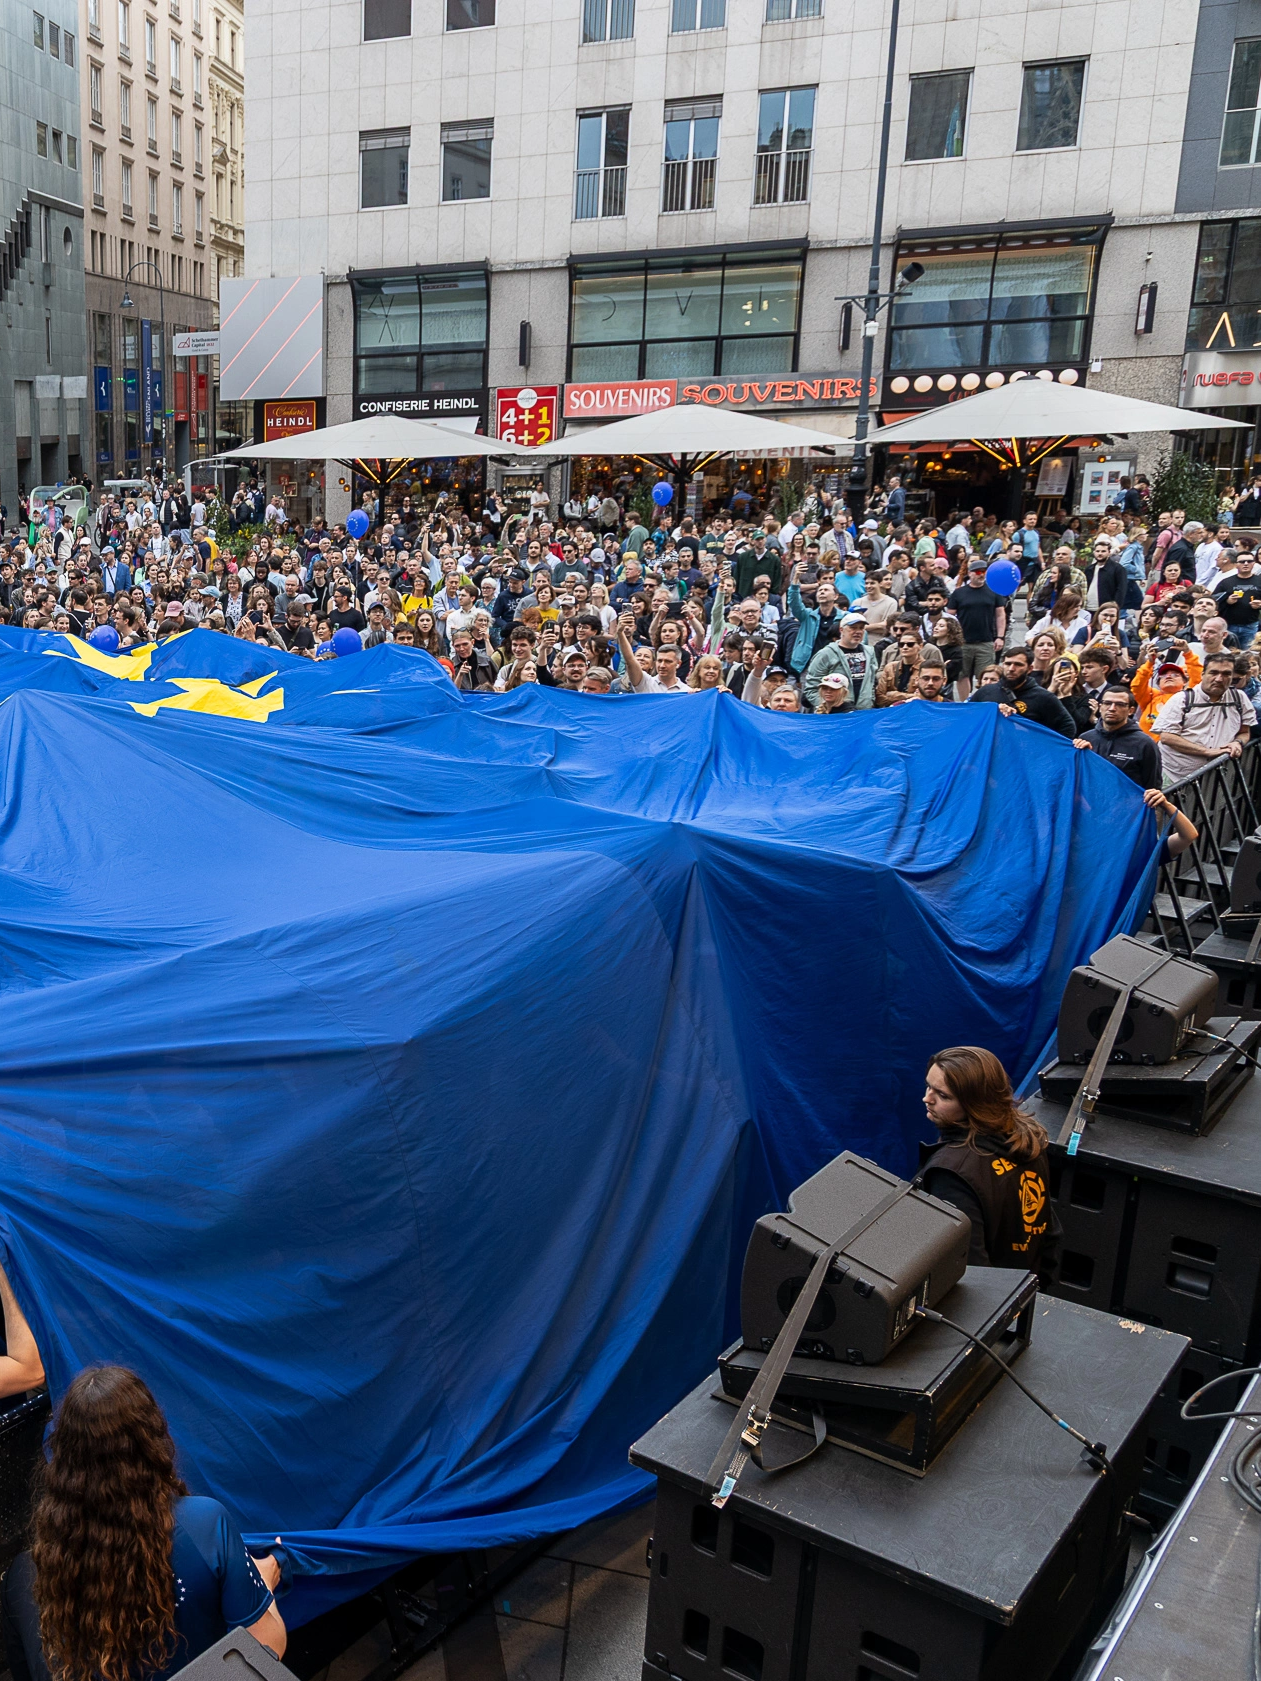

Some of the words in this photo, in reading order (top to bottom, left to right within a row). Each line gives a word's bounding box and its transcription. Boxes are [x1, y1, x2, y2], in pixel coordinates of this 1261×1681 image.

[1194, 371, 1255, 387] ruefa
[359, 399, 430, 413] CONFISERIE
[433, 397, 479, 410] HEINDL
[570, 387, 671, 410] SOUVENIRS
[267, 417, 313, 427] HEINDL
